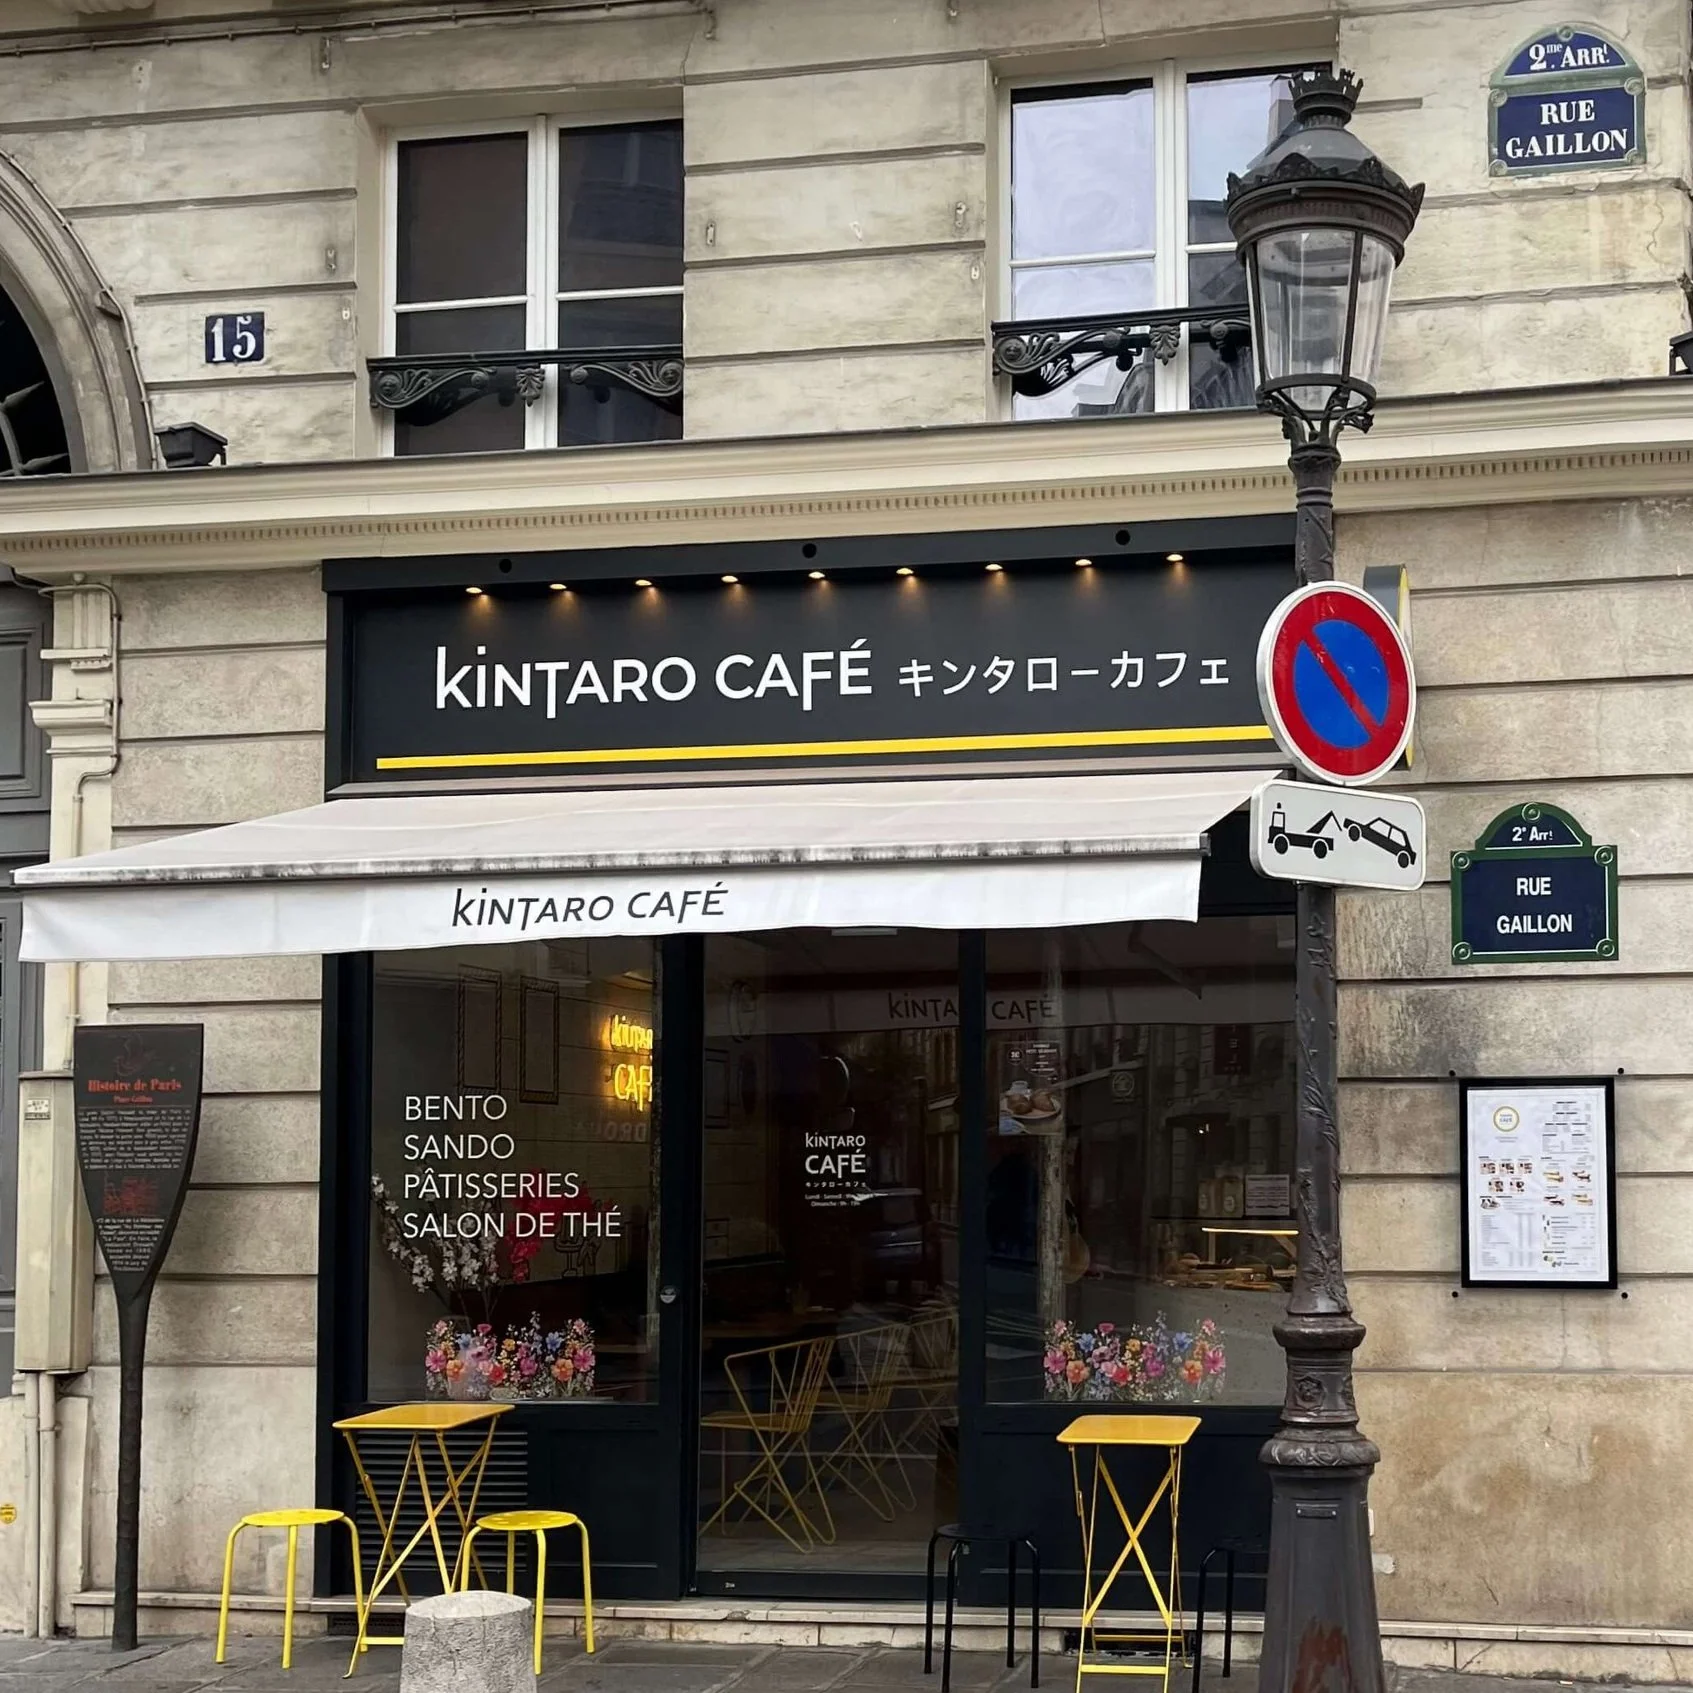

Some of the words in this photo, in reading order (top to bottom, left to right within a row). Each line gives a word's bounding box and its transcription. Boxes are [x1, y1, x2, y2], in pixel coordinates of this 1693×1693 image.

[1540, 99, 1595, 125] RUE
[1505, 128, 1628, 159] GAILLON
[211, 314, 257, 361] 15
[715, 638, 873, 711] CAFÉ
[898, 650, 1230, 697] キンタローカフェ
[1516, 876, 1552, 896] RUE
[627, 881, 729, 924] CAFÉ
[1496, 914, 1573, 934] GAILLON
[404, 1094, 507, 1121] BENTO
[404, 1133, 515, 1160] SANDO
[805, 1148, 866, 1179] CAFÉ
[404, 1167, 580, 1199] PÂTISSERIES
[403, 1212, 504, 1239] SALON
[516, 1212, 555, 1238] DE
[562, 1205, 622, 1238] THÉ
